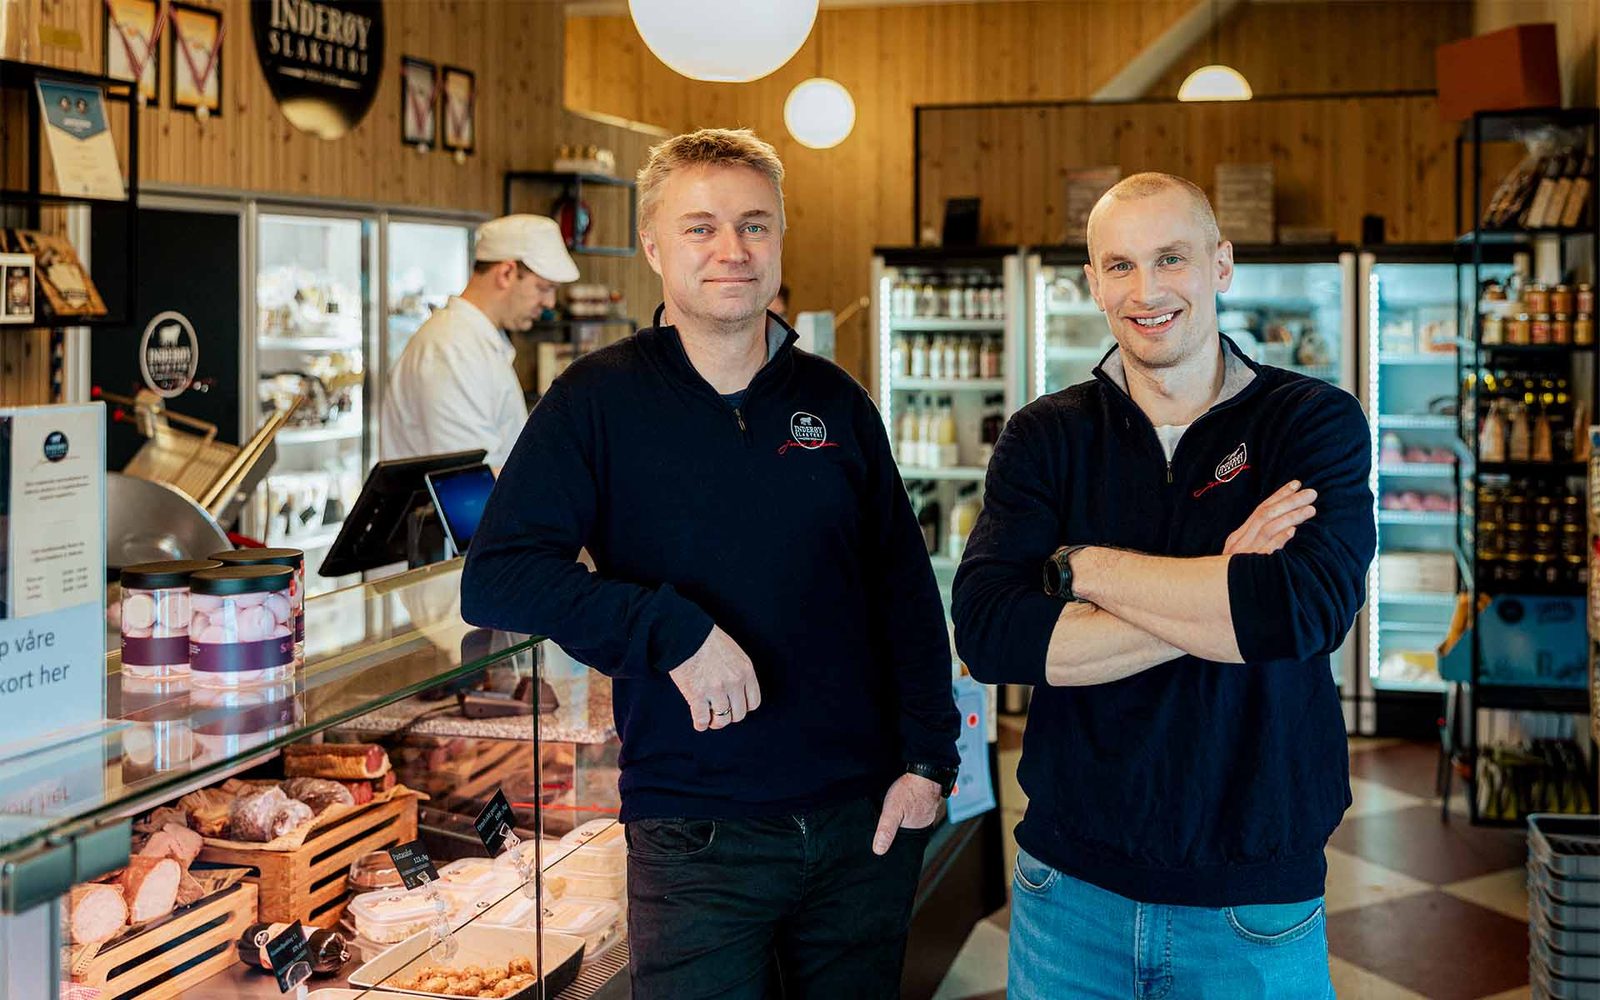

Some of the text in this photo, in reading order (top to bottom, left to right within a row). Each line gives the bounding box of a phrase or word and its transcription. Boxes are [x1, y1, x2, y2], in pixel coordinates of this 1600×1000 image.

[271, 0, 371, 50] INDERØY
[268, 31, 369, 76] SLAKTERI
[15, 628, 56, 653] våre
[40, 663, 71, 684] her
